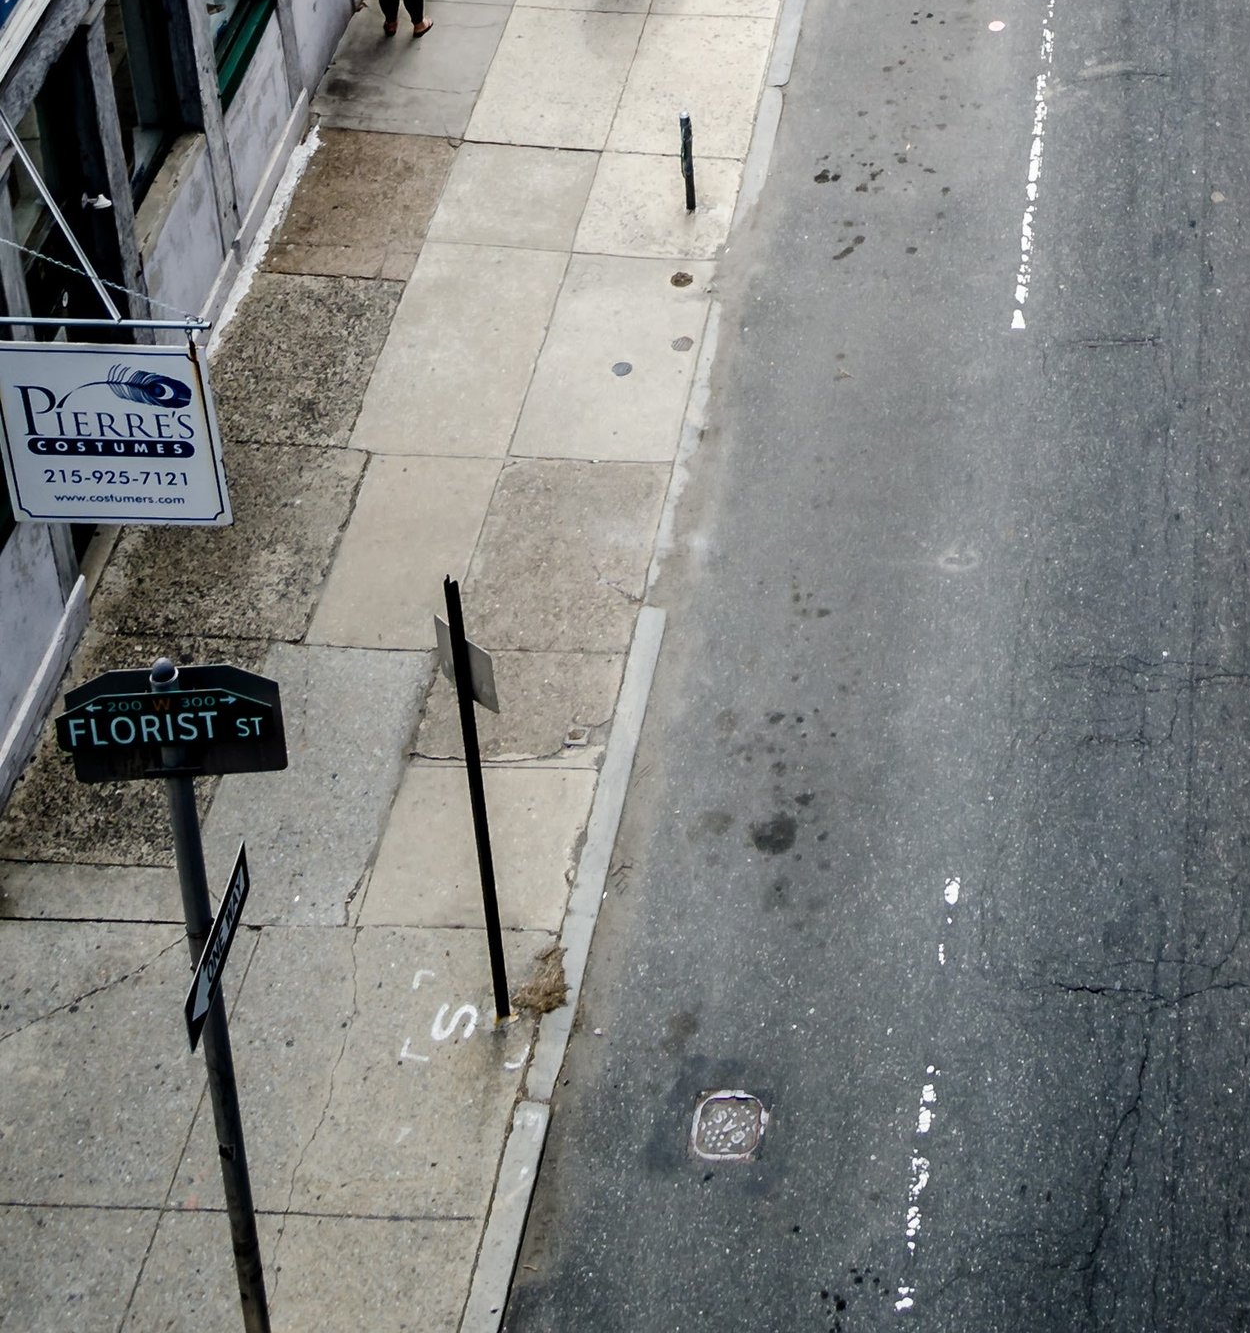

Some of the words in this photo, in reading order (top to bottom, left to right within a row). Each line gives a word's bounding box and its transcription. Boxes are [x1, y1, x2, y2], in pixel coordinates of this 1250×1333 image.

[13, 385, 195, 439] PIERRE'S
[37, 440, 183, 454] COSTUMES
[44, 469, 188, 486] 215-925-7121
[54, 494, 185, 504] www.costumers.com
[107, 700, 142, 712] 200
[152, 697, 171, 712] W
[181, 696, 216, 708] 300
[68, 711, 218, 747] FLORIST
[235, 717, 263, 737] ST
[207, 927, 226, 984] ONE
[224, 876, 242, 930] WAY
